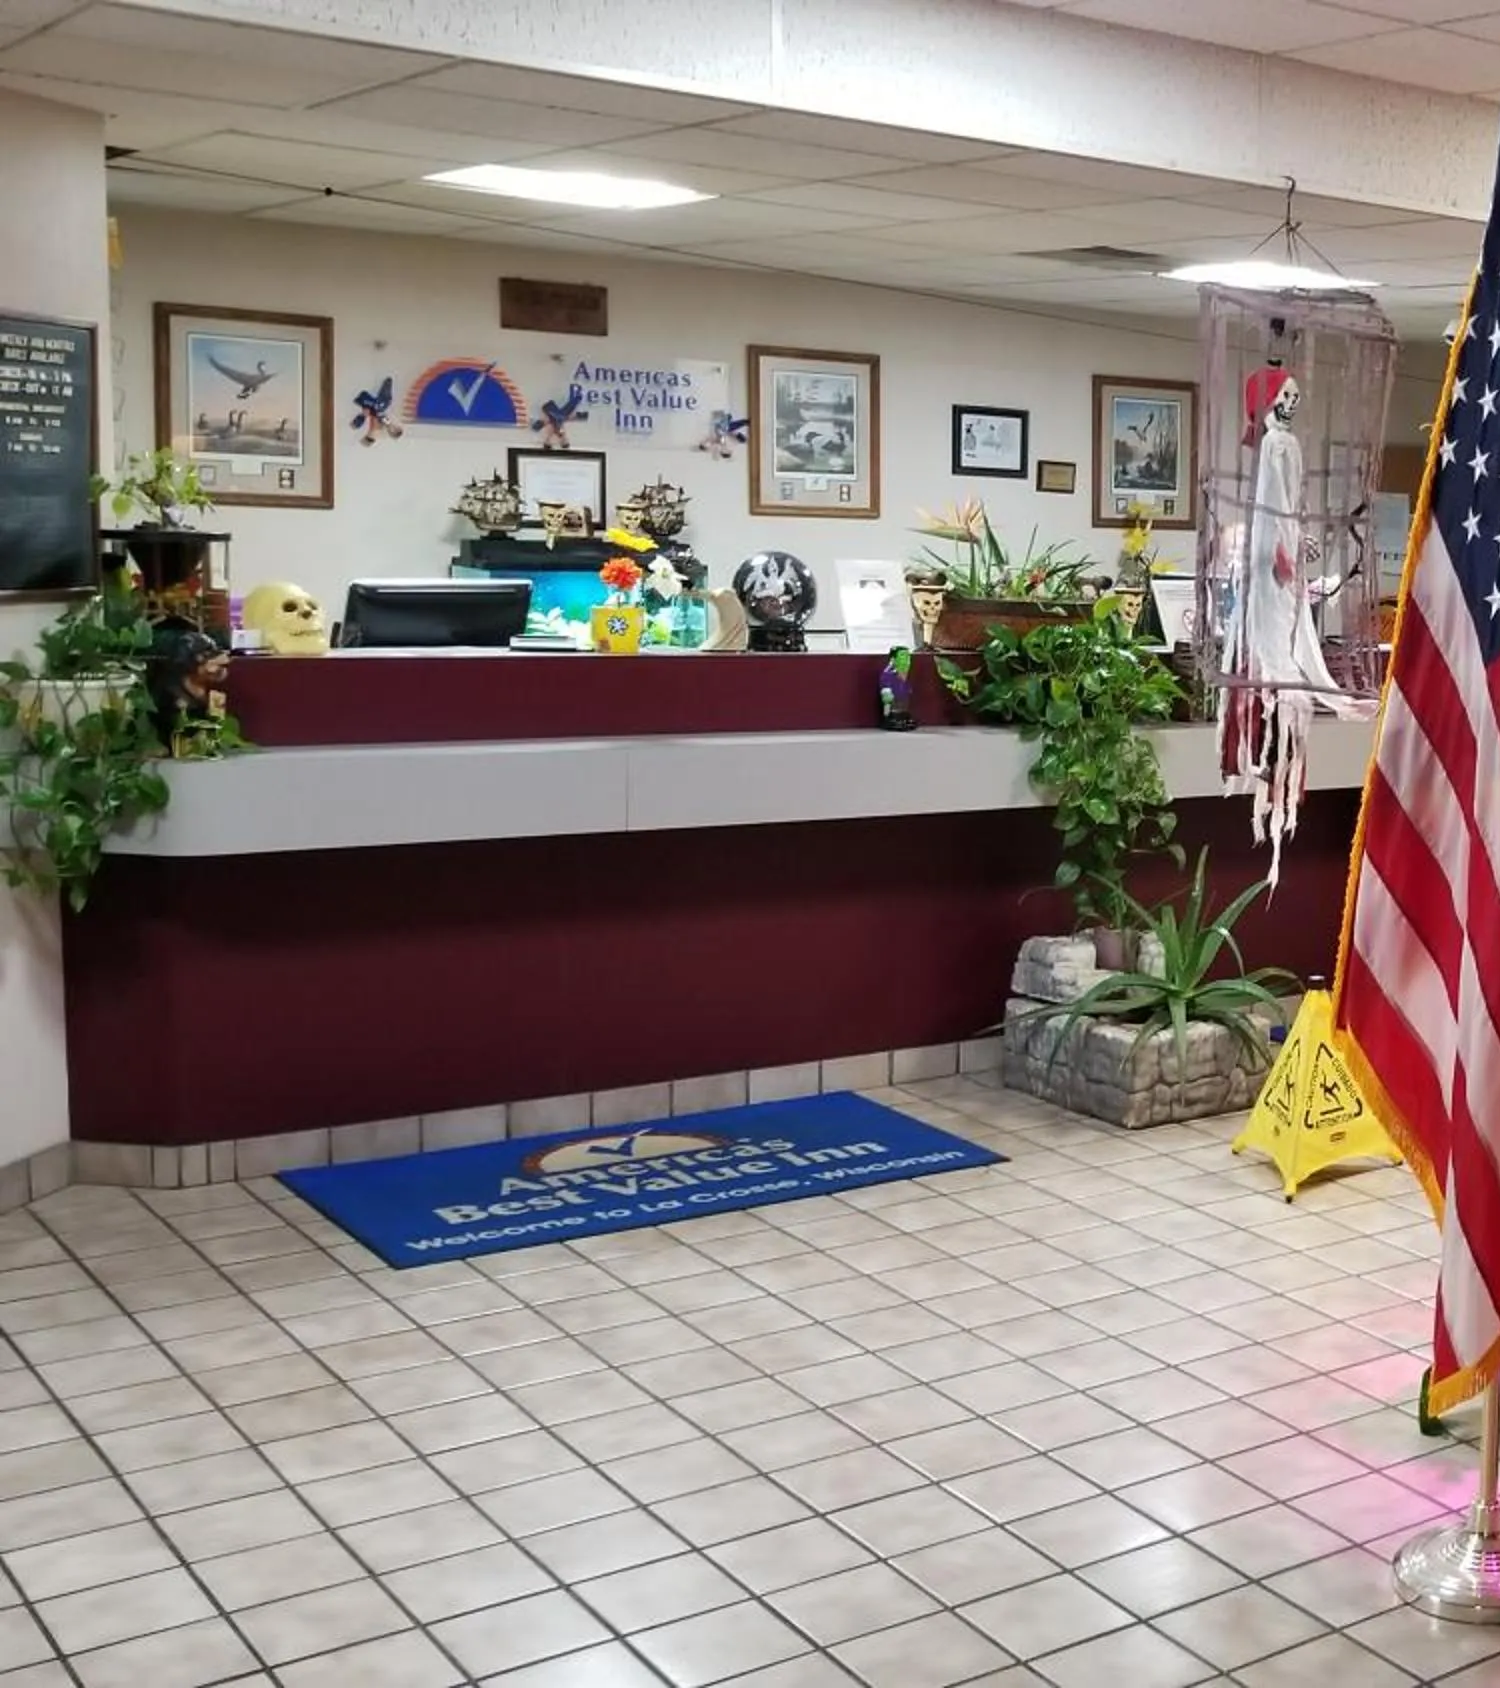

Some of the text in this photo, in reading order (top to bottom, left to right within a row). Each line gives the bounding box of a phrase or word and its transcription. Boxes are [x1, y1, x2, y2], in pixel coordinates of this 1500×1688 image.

[615, 408, 654, 428] Inn
[630, 386, 698, 410] Value
[406, 1215, 587, 1250] Welcome
[594, 1208, 632, 1221] to
[639, 1199, 685, 1212] La
[810, 1150, 965, 1181] Wisconsin
[433, 1140, 889, 1225] Best Value Inn
